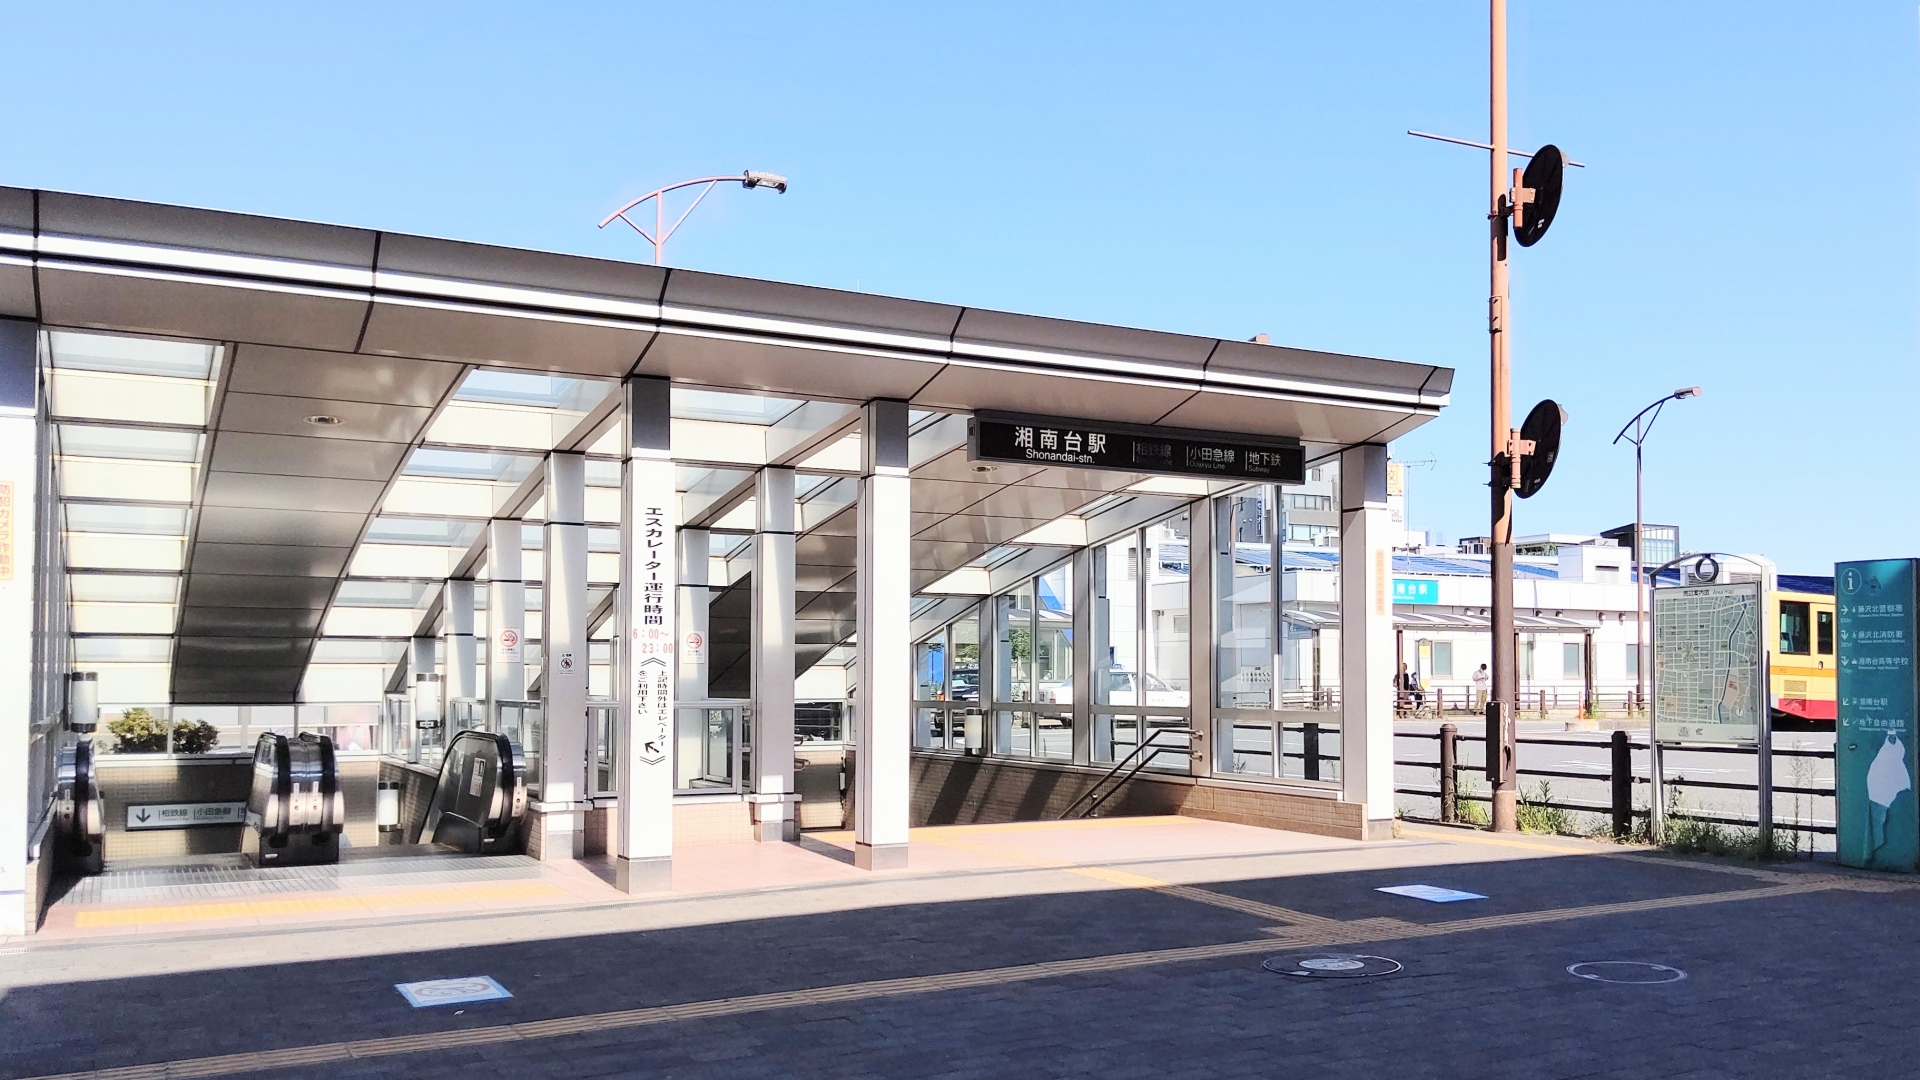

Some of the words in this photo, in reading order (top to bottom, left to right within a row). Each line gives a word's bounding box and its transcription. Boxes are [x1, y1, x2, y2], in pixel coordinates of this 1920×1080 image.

[1014, 426, 1106, 454] 湘南台駅
[1025, 448, 1095, 465] Shonandai-stn.
[1190, 447, 1236, 463] 小田急線
[1248, 452, 1282, 467] 地下鉄
[1248, 465, 1270, 474] Subway
[0, 484, 10, 576] 防犯カメラ作動中
[644, 507, 664, 625] エスカレーター運行時間
[657, 670, 668, 747] 上記時間外はエレベーター
